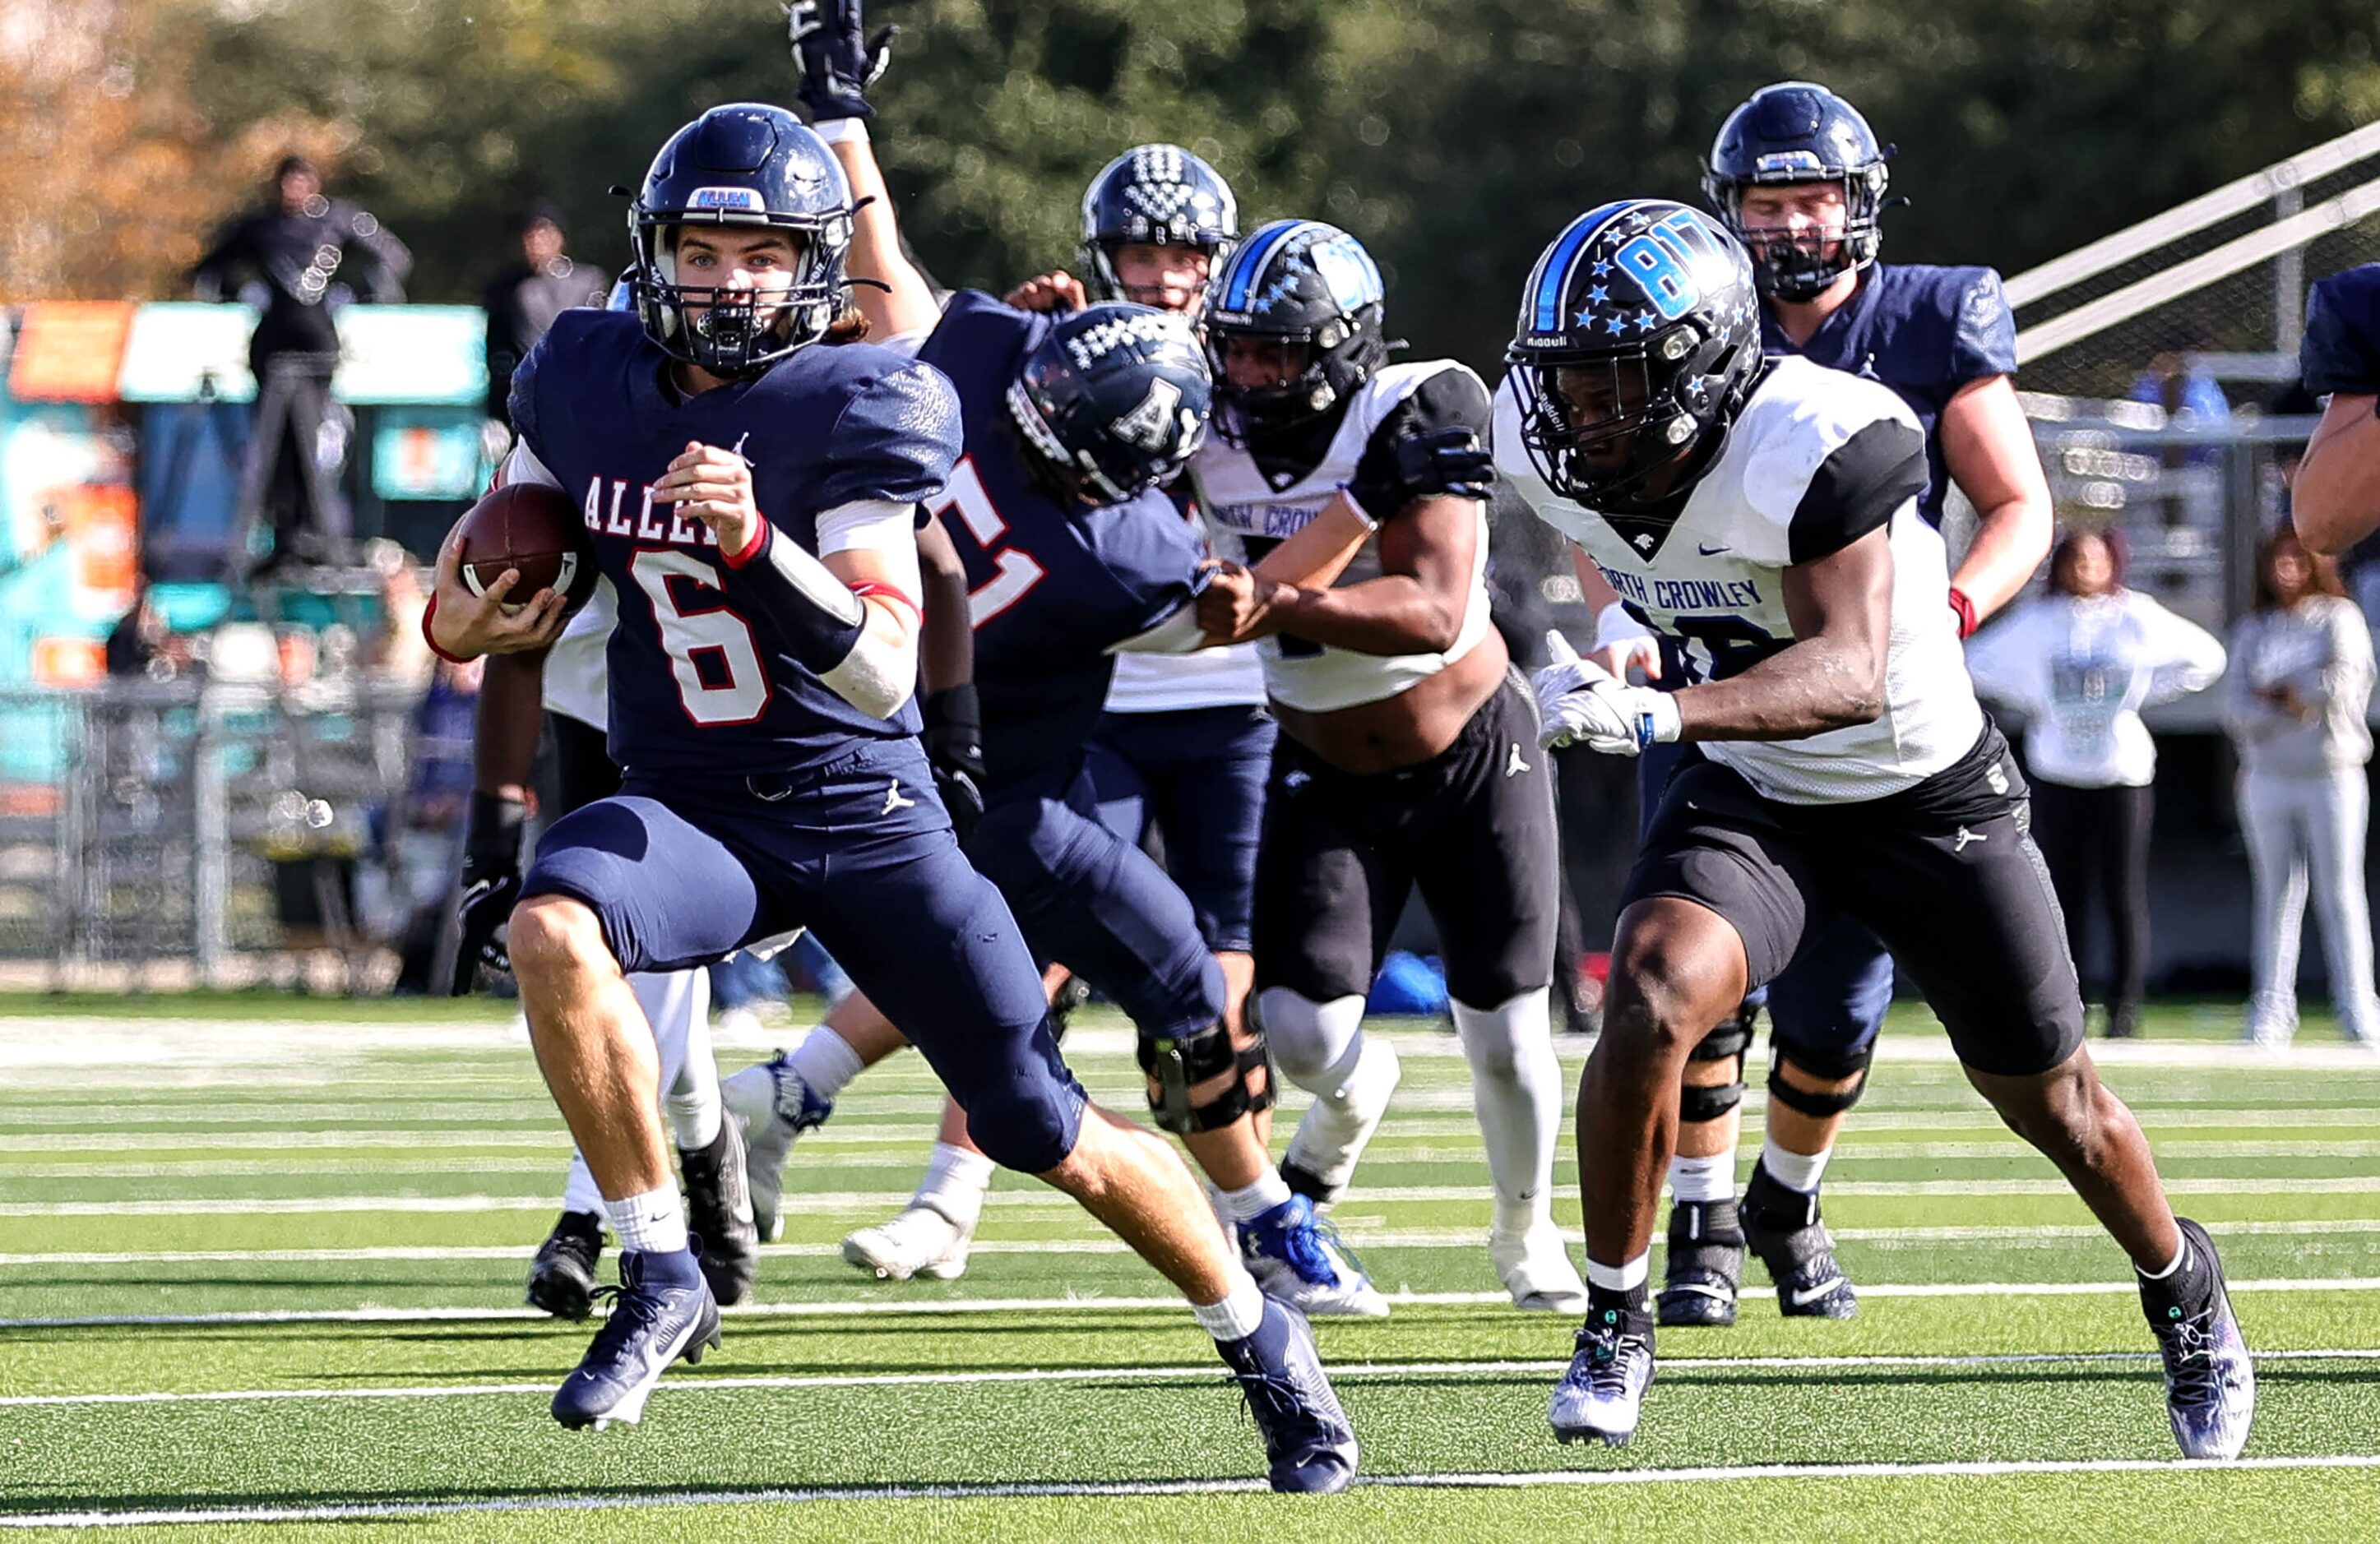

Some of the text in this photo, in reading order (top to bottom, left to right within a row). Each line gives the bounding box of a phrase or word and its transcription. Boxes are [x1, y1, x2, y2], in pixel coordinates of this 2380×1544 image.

[697, 190, 751, 209] ALLEN
[1109, 377, 1182, 453] A
[584, 475, 718, 547] ALLE
[1654, 580, 1763, 610] CROWLEY
[627, 547, 774, 728] 6
